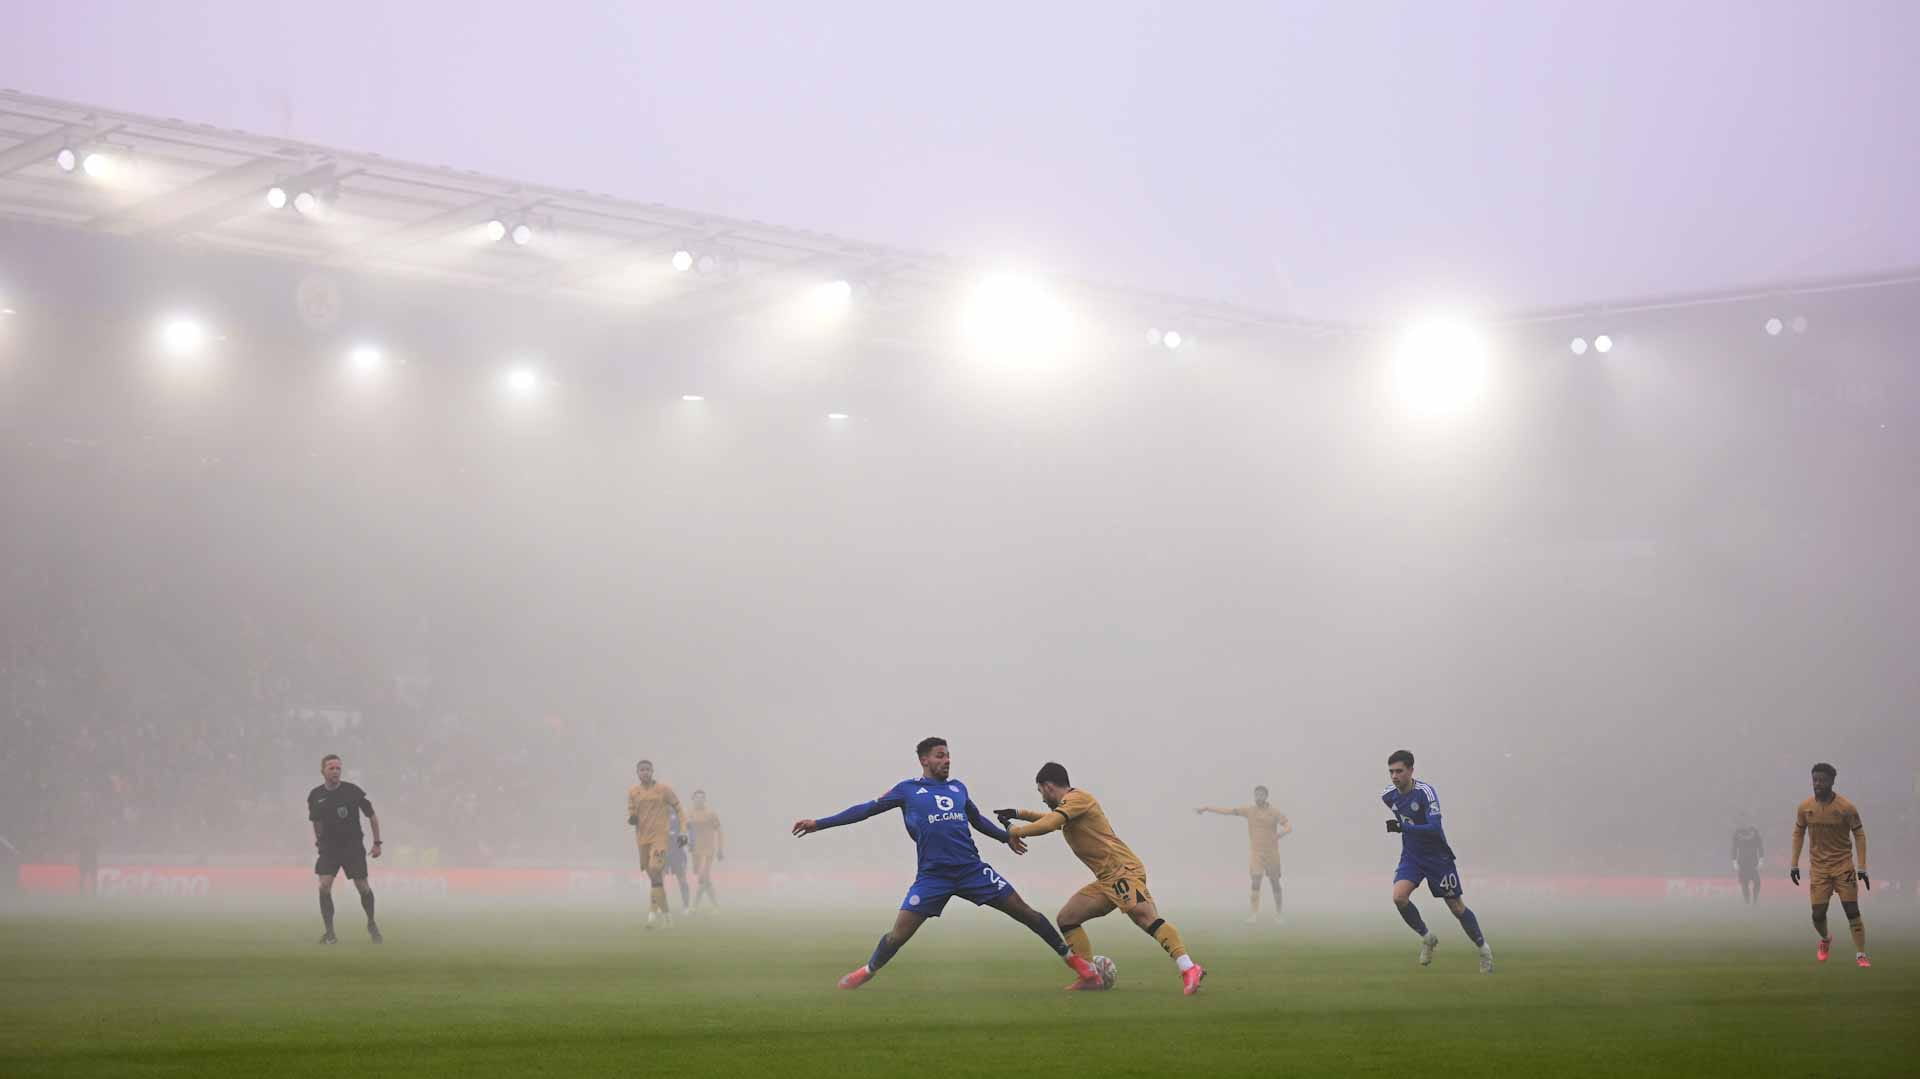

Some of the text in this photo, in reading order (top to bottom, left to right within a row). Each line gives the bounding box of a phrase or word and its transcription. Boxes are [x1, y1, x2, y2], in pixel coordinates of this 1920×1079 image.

[928, 812, 966, 824] BC.GAME
[1112, 878, 1130, 895] 10
[1440, 873, 1457, 890] 40
